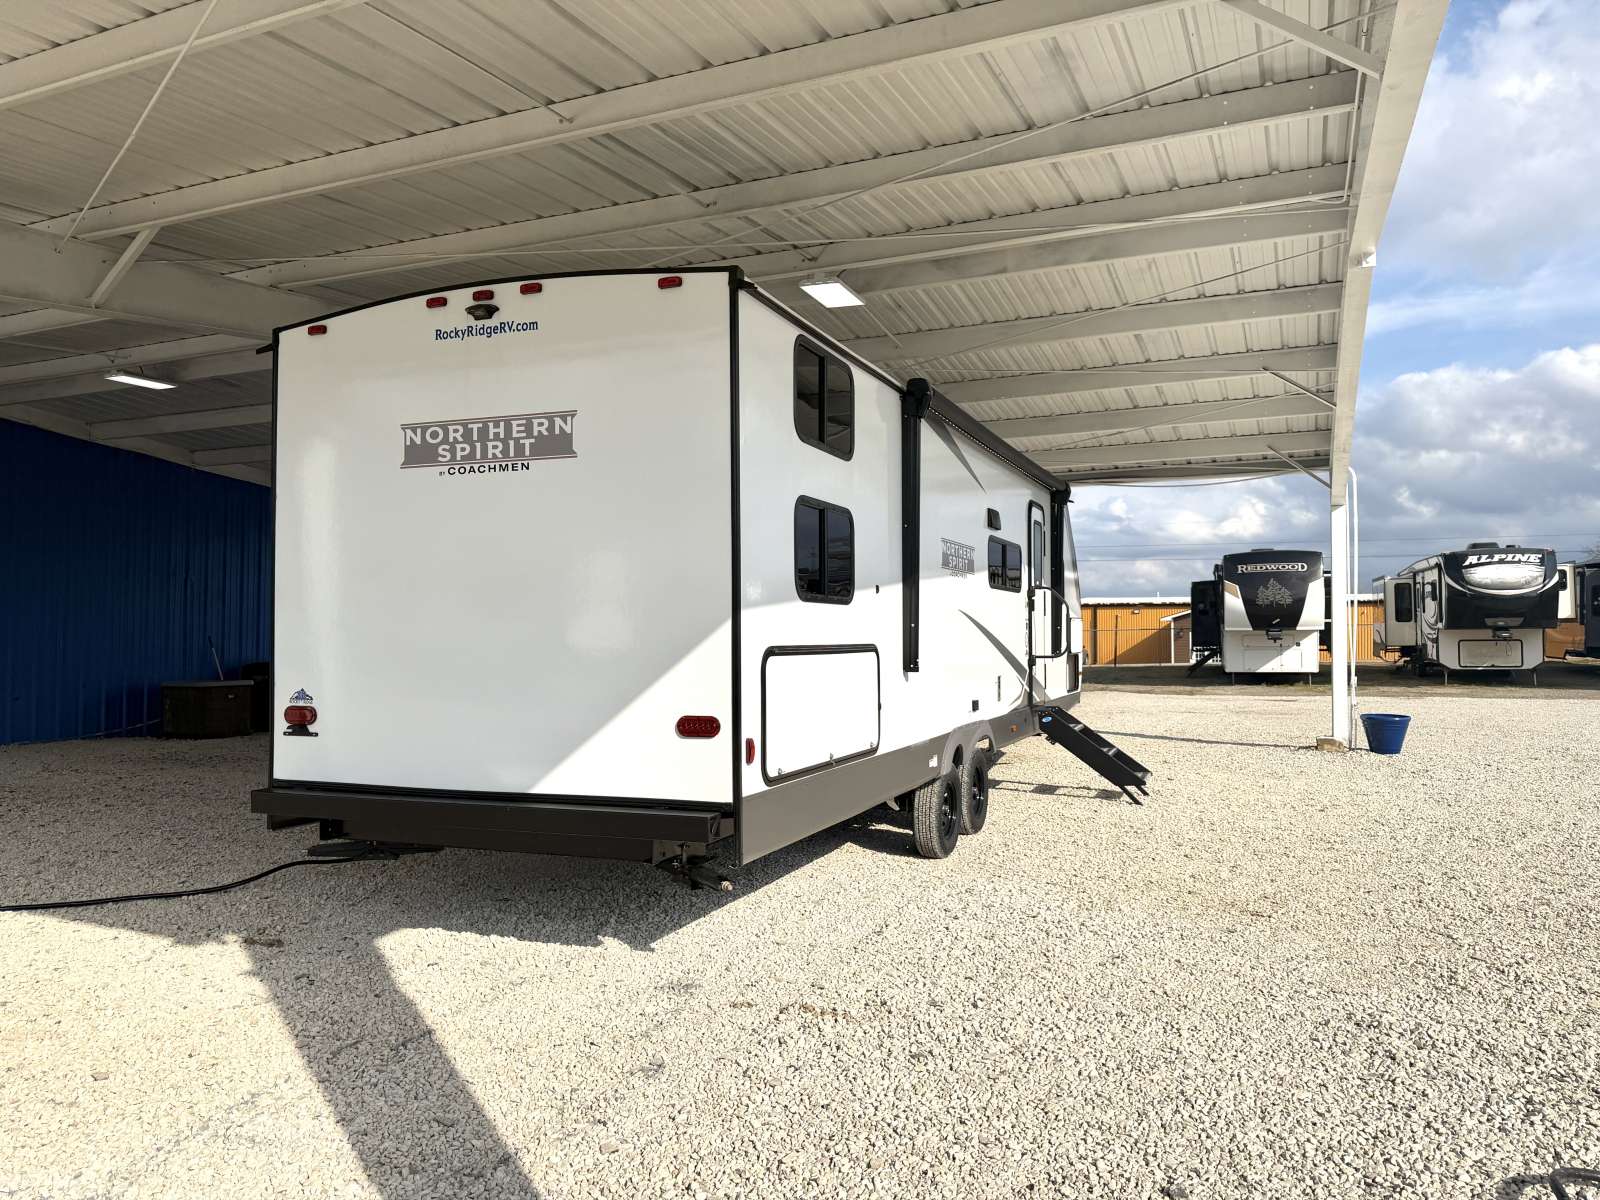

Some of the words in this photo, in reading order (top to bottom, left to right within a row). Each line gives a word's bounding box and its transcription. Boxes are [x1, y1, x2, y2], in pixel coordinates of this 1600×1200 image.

[435, 320, 539, 341] RockyRidgeRV.com
[404, 415, 573, 446] NORTHERN
[437, 438, 536, 462] SPIRIT
[447, 462, 531, 476] COACHMEN
[941, 540, 975, 561] NORTHERN
[1462, 553, 1543, 567] ALPINE
[948, 555, 969, 572] SPIRIT
[1237, 562, 1308, 574] REDWOOD
